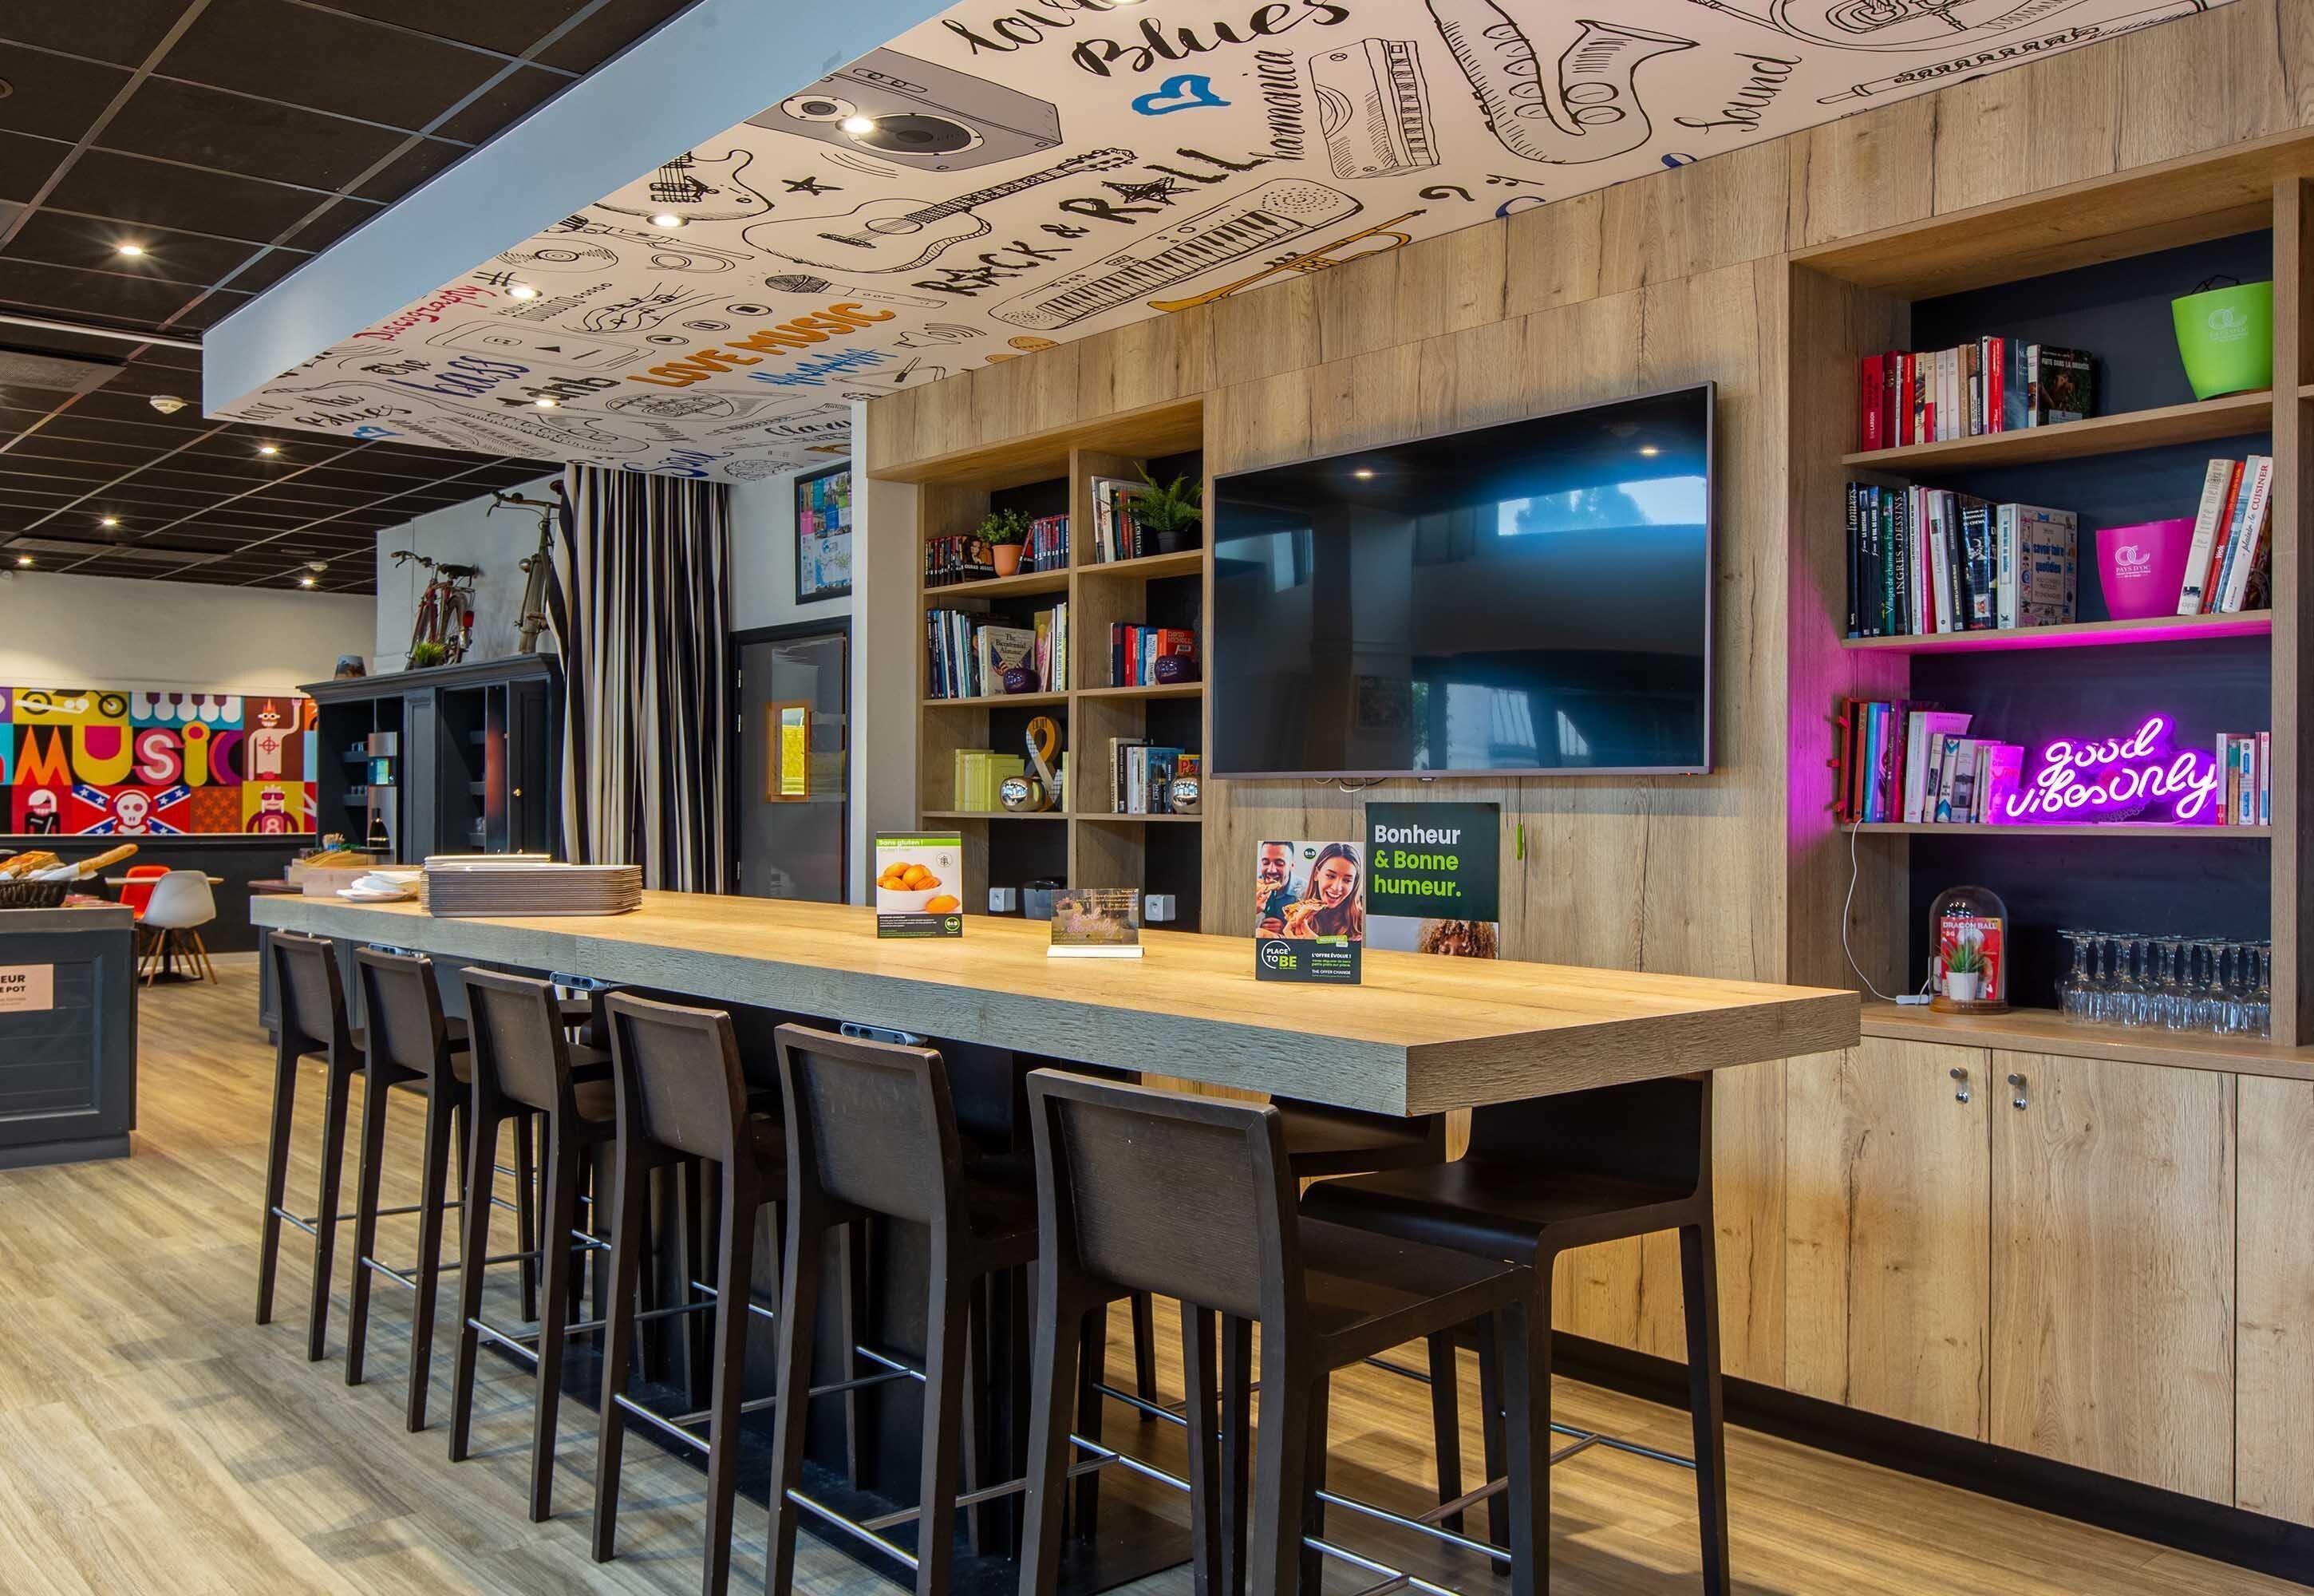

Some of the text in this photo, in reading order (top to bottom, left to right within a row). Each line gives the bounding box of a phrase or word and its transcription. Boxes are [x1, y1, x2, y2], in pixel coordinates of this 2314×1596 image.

[1072, 0, 1349, 77] Blues
[1242, 46, 1305, 161] harmonica
[1674, 52, 1802, 134] Sound
[1040, 221, 1090, 239] &
[353, 285, 498, 342] Discography
[626, 303, 896, 388] LOVE MUSIC
[2252, 464, 2269, 511] CUISINER
[1894, 496, 1905, 595] INGRES DESSINS
[2037, 717, 2163, 786] good
[2006, 752, 2217, 819] vibes only
[1374, 850, 1459, 871] & Bonne
[1375, 824, 1461, 845] Bonheur
[1374, 875, 1462, 898] humeur.
[1279, 956, 1297, 967] BE
